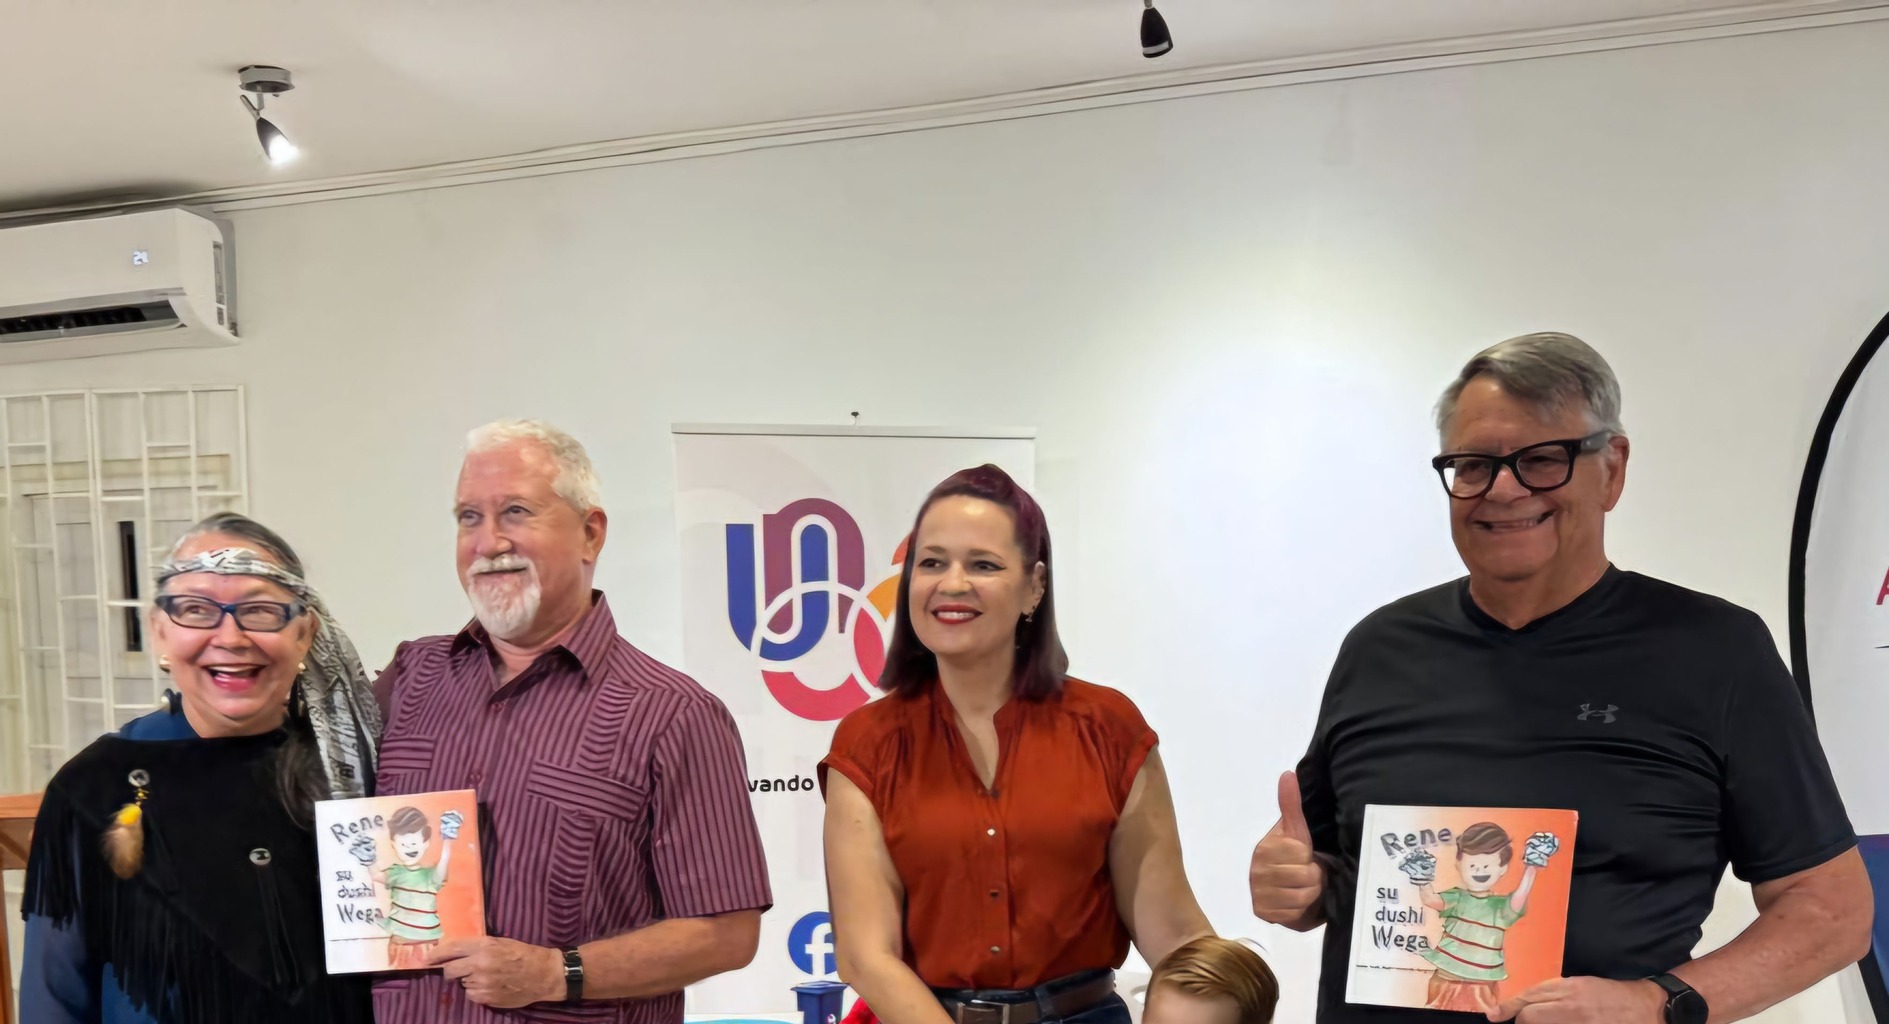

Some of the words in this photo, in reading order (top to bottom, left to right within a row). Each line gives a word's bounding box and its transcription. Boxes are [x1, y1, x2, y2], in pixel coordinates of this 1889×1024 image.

[748, 775, 814, 792] vando
[330, 814, 384, 845] Rene
[1380, 827, 1452, 858] Rene
[1377, 887, 1398, 900] su
[336, 903, 385, 926] Wega
[1375, 906, 1424, 924] dushi
[1371, 925, 1429, 952] Wega
